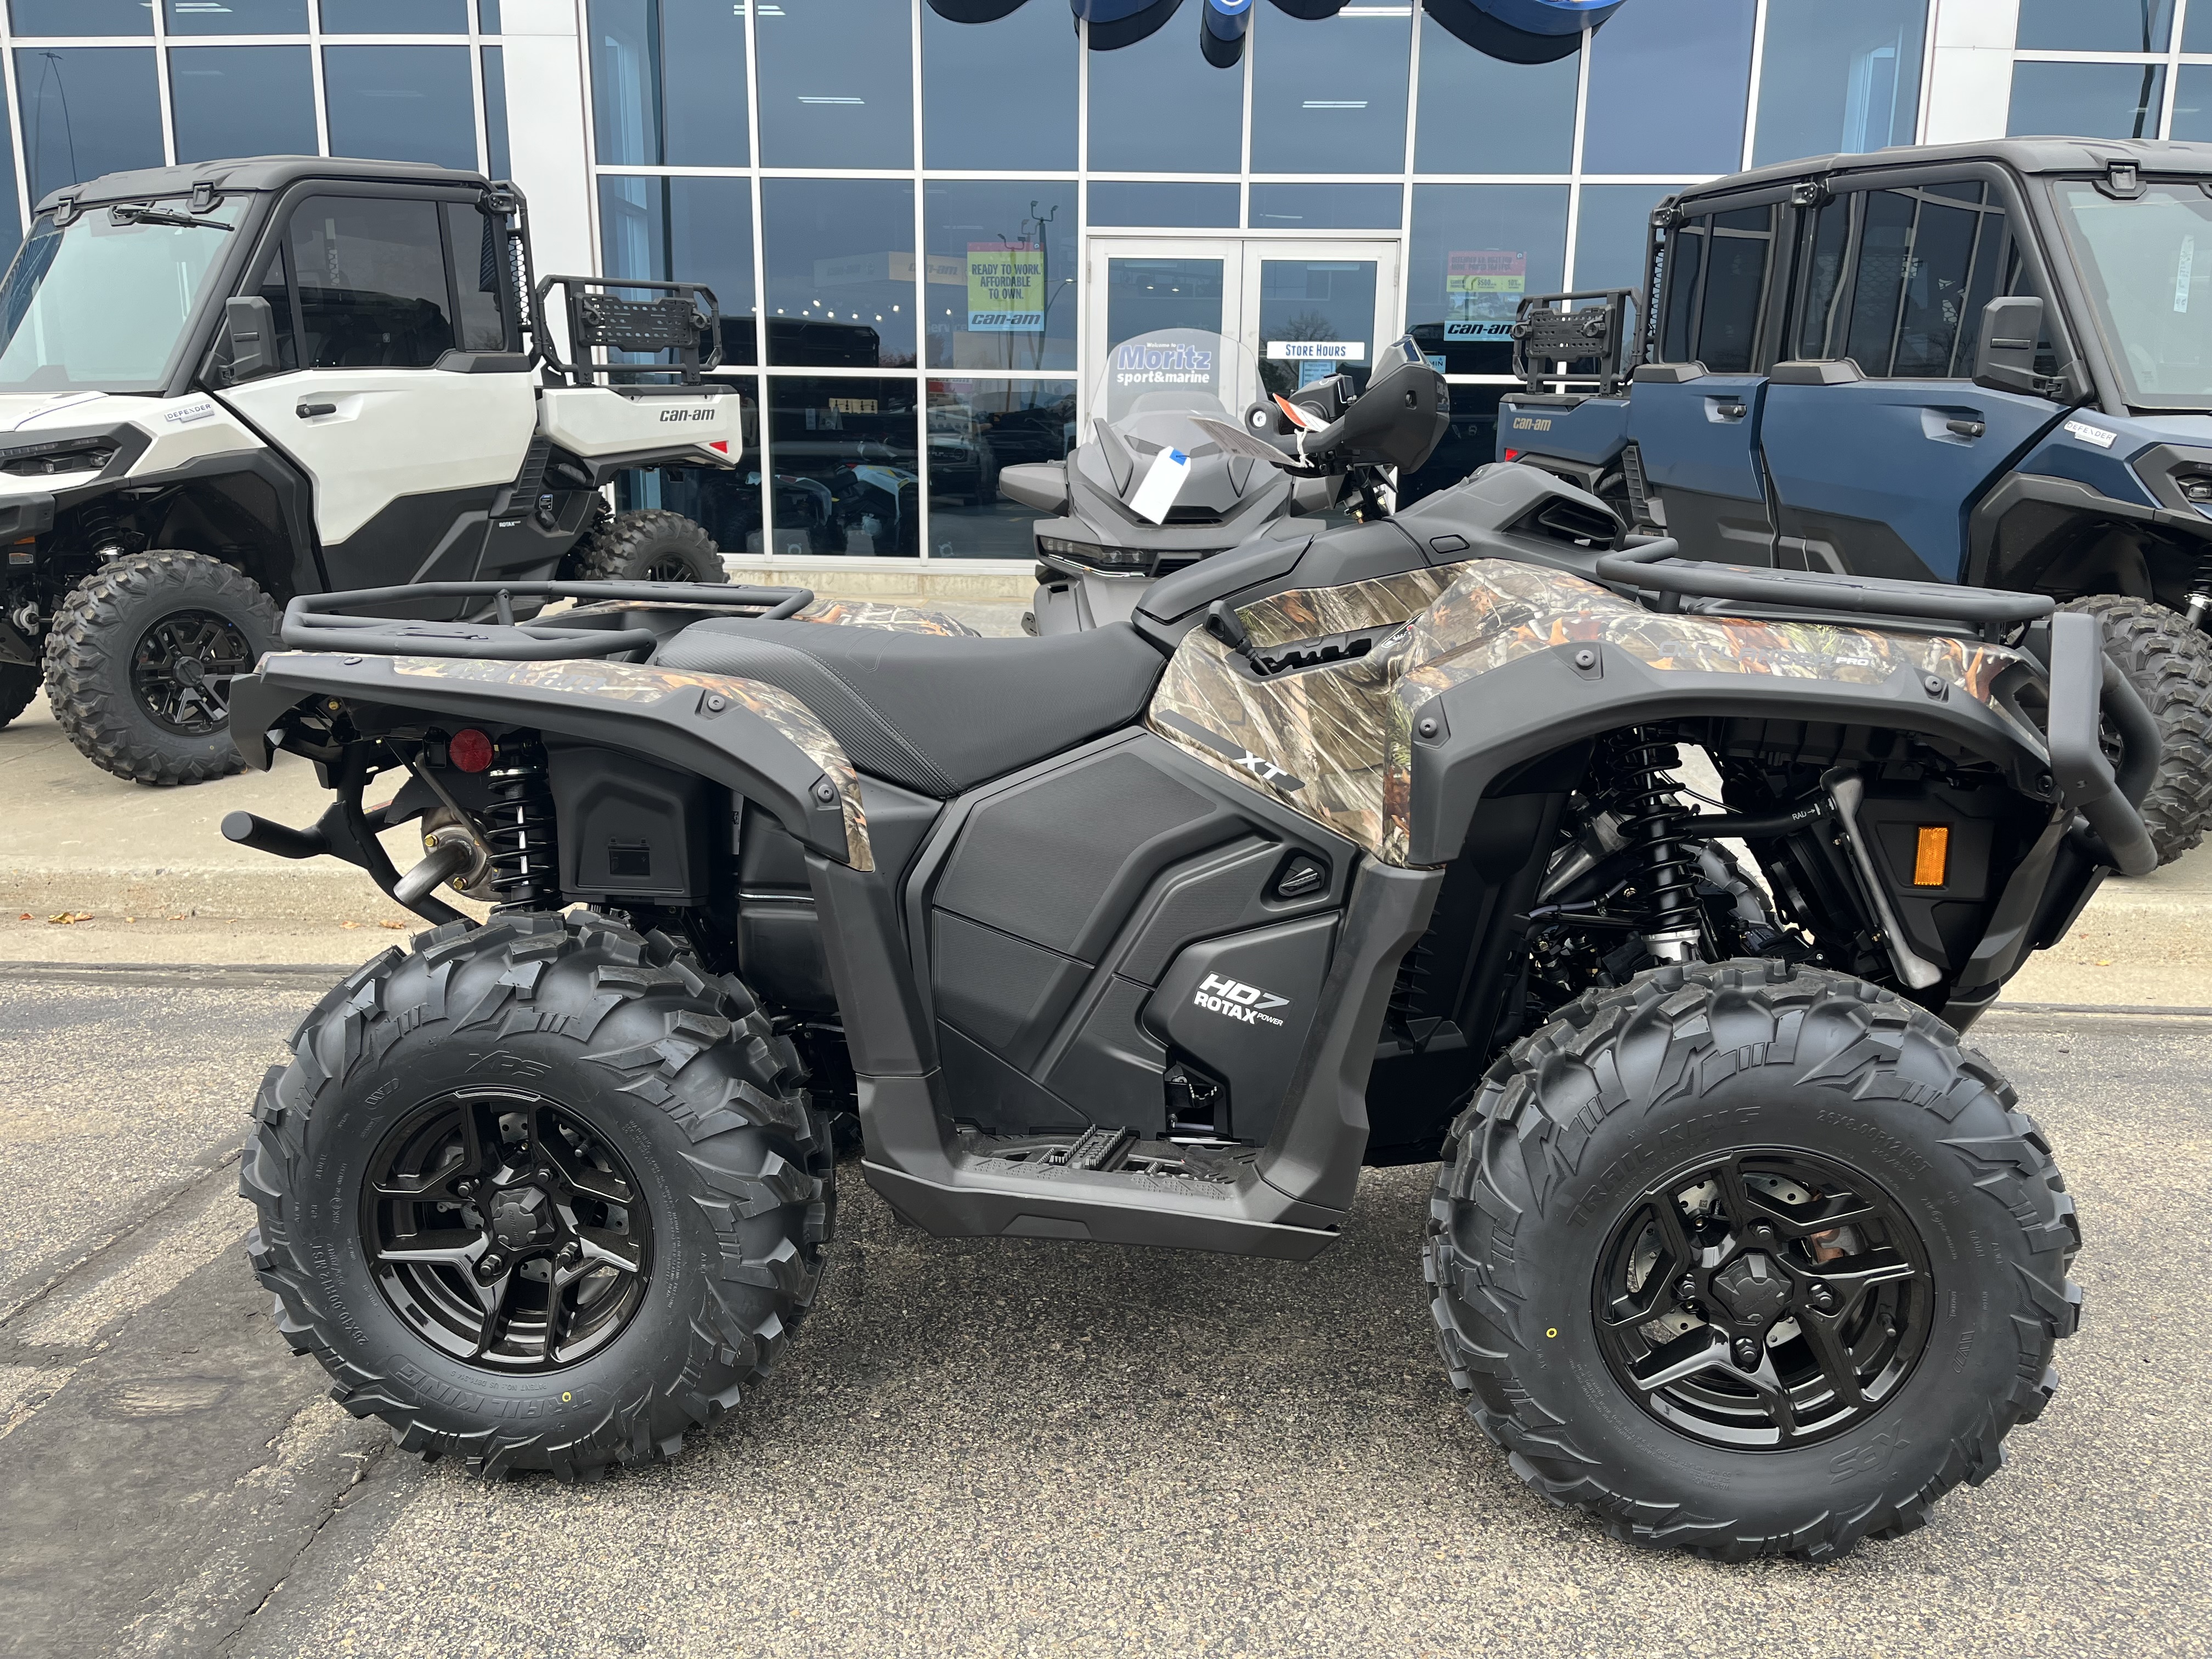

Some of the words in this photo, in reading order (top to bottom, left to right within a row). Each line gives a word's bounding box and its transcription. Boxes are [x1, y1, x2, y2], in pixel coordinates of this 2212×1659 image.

[972, 264, 998, 275] READY
[1001, 264, 1012, 275] TO
[1014, 264, 1041, 275] WORK.
[980, 276, 1031, 287] AFFORDABLE
[989, 289, 999, 299] TO
[1002, 289, 1024, 300] OWN.
[972, 314, 1041, 325] can-am
[1117, 344, 1212, 370] Moritz
[1286, 344, 1314, 356] STORE
[1317, 345, 1346, 357] HOURS
[1117, 370, 1210, 386] sport&marine
[167, 403, 212, 419] DEFENDER
[659, 409, 715, 422] can-am
[1513, 417, 1551, 431] can-am
[2067, 422, 2113, 441] DEFENDER
[1233, 749, 1288, 780] XT
[1199, 973, 1290, 1009] HD7
[1194, 991, 1258, 1024] ROTAX
[1257, 1012, 1284, 1026] POWER
